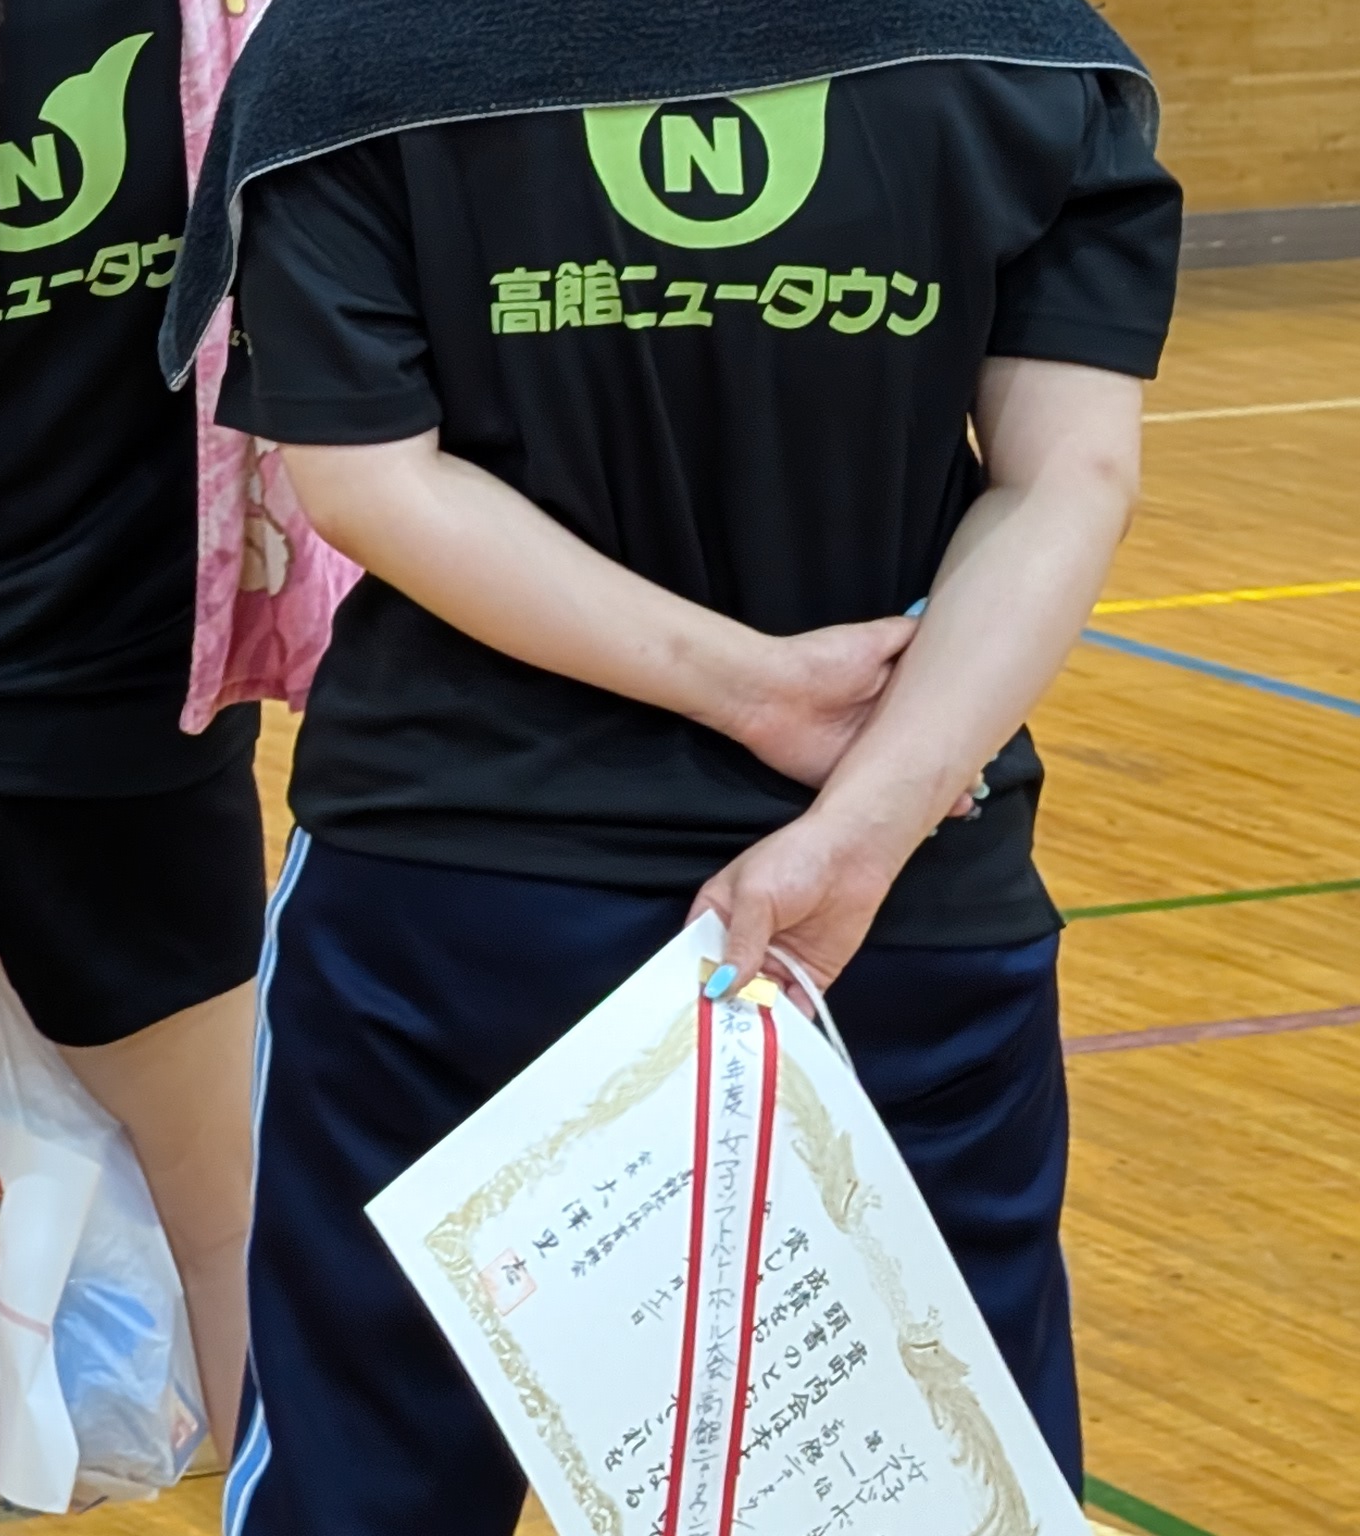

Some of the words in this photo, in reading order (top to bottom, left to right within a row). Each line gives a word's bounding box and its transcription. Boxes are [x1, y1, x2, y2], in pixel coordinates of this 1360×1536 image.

[660, 114, 744, 195] N
[490, 259, 940, 337] 高館ニュータウン
